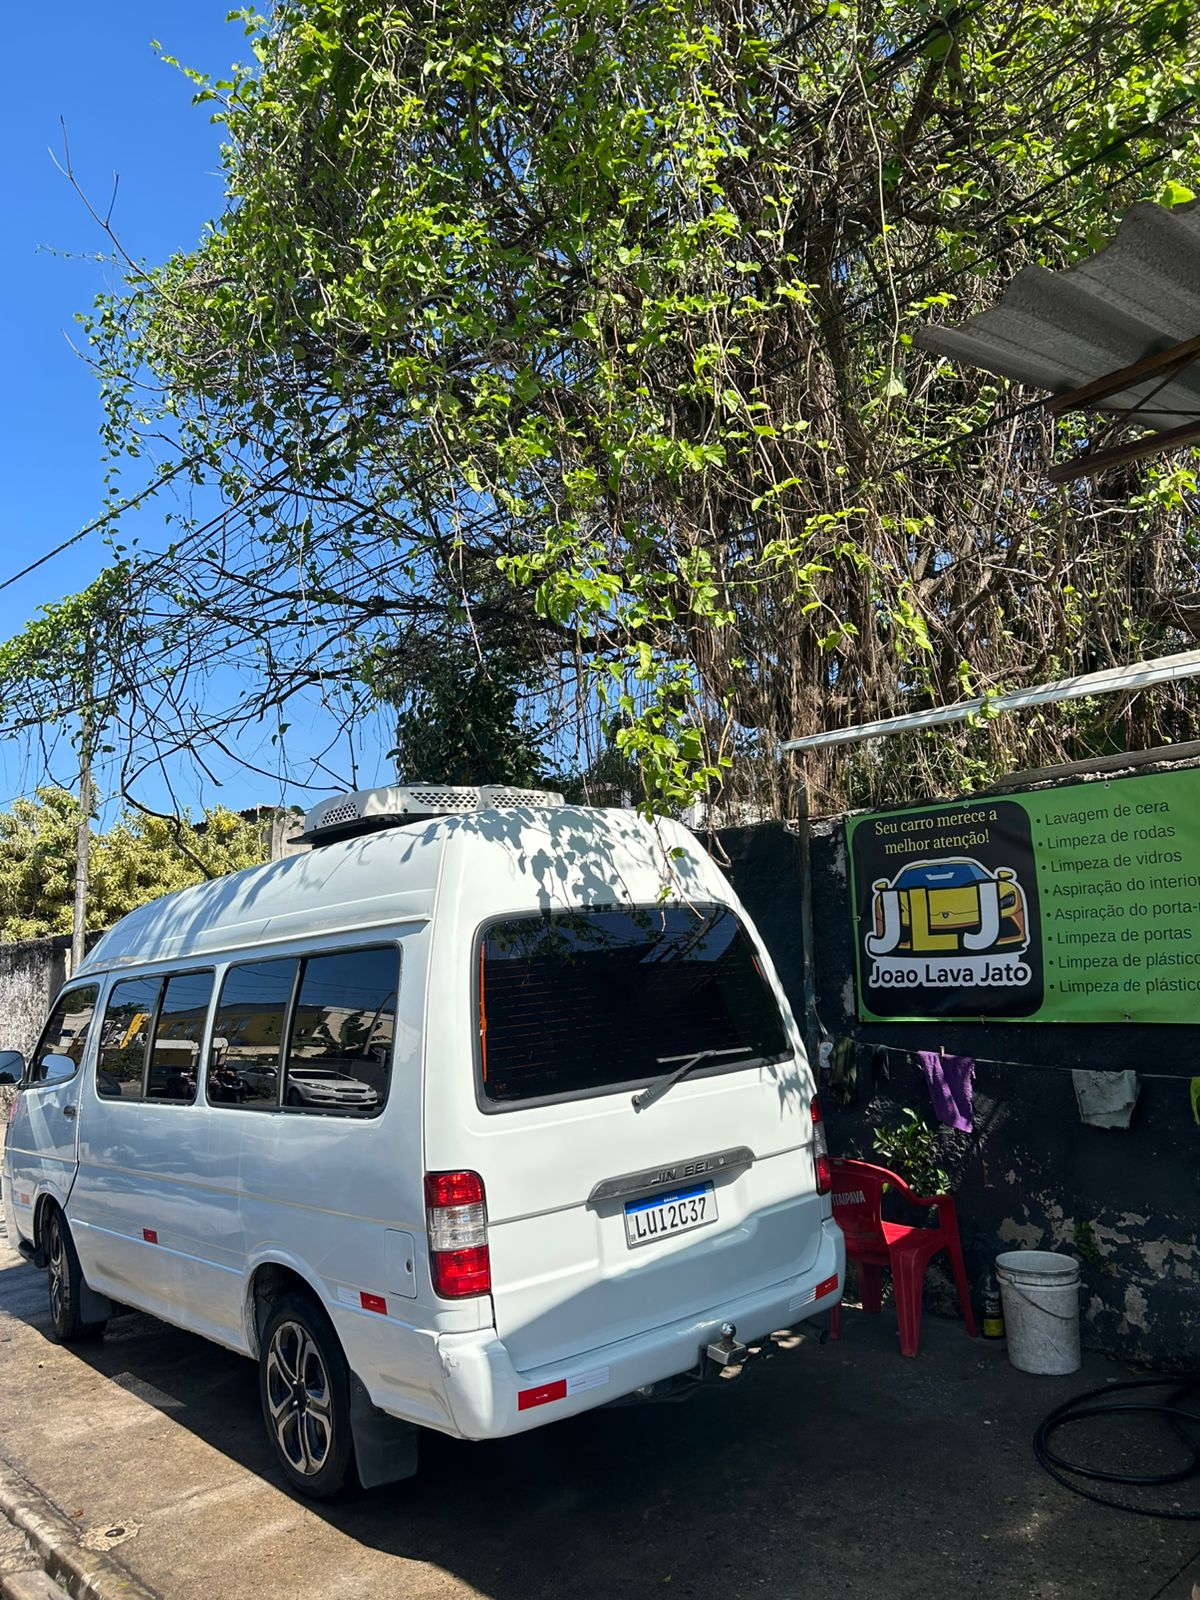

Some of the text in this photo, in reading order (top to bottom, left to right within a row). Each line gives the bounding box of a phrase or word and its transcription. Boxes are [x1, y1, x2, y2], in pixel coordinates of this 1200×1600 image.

[875, 809, 998, 836] Seu carro merece a
[1045, 801, 1170, 826] Lavagem de cera
[885, 828, 990, 855] melhor atenção!
[1047, 825, 1176, 850] Limpeza de rodas
[1050, 851, 1182, 874] Limpeza de vidros
[1052, 879, 1122, 898] Aspiração
[1126, 878, 1145, 891] do
[869, 882, 1000, 953] JLJ
[1054, 901, 1200, 923] Aspiração do porta-
[1057, 927, 1192, 946] Limpeza de portas
[871, 962, 1028, 984] Joao Lava Jato
[1058, 955, 1118, 971] Limpeza
[1122, 953, 1142, 967] de
[1059, 979, 1119, 996] Limpeza
[1123, 978, 1141, 991] de
[635, 1196, 706, 1238] LUI2C37
